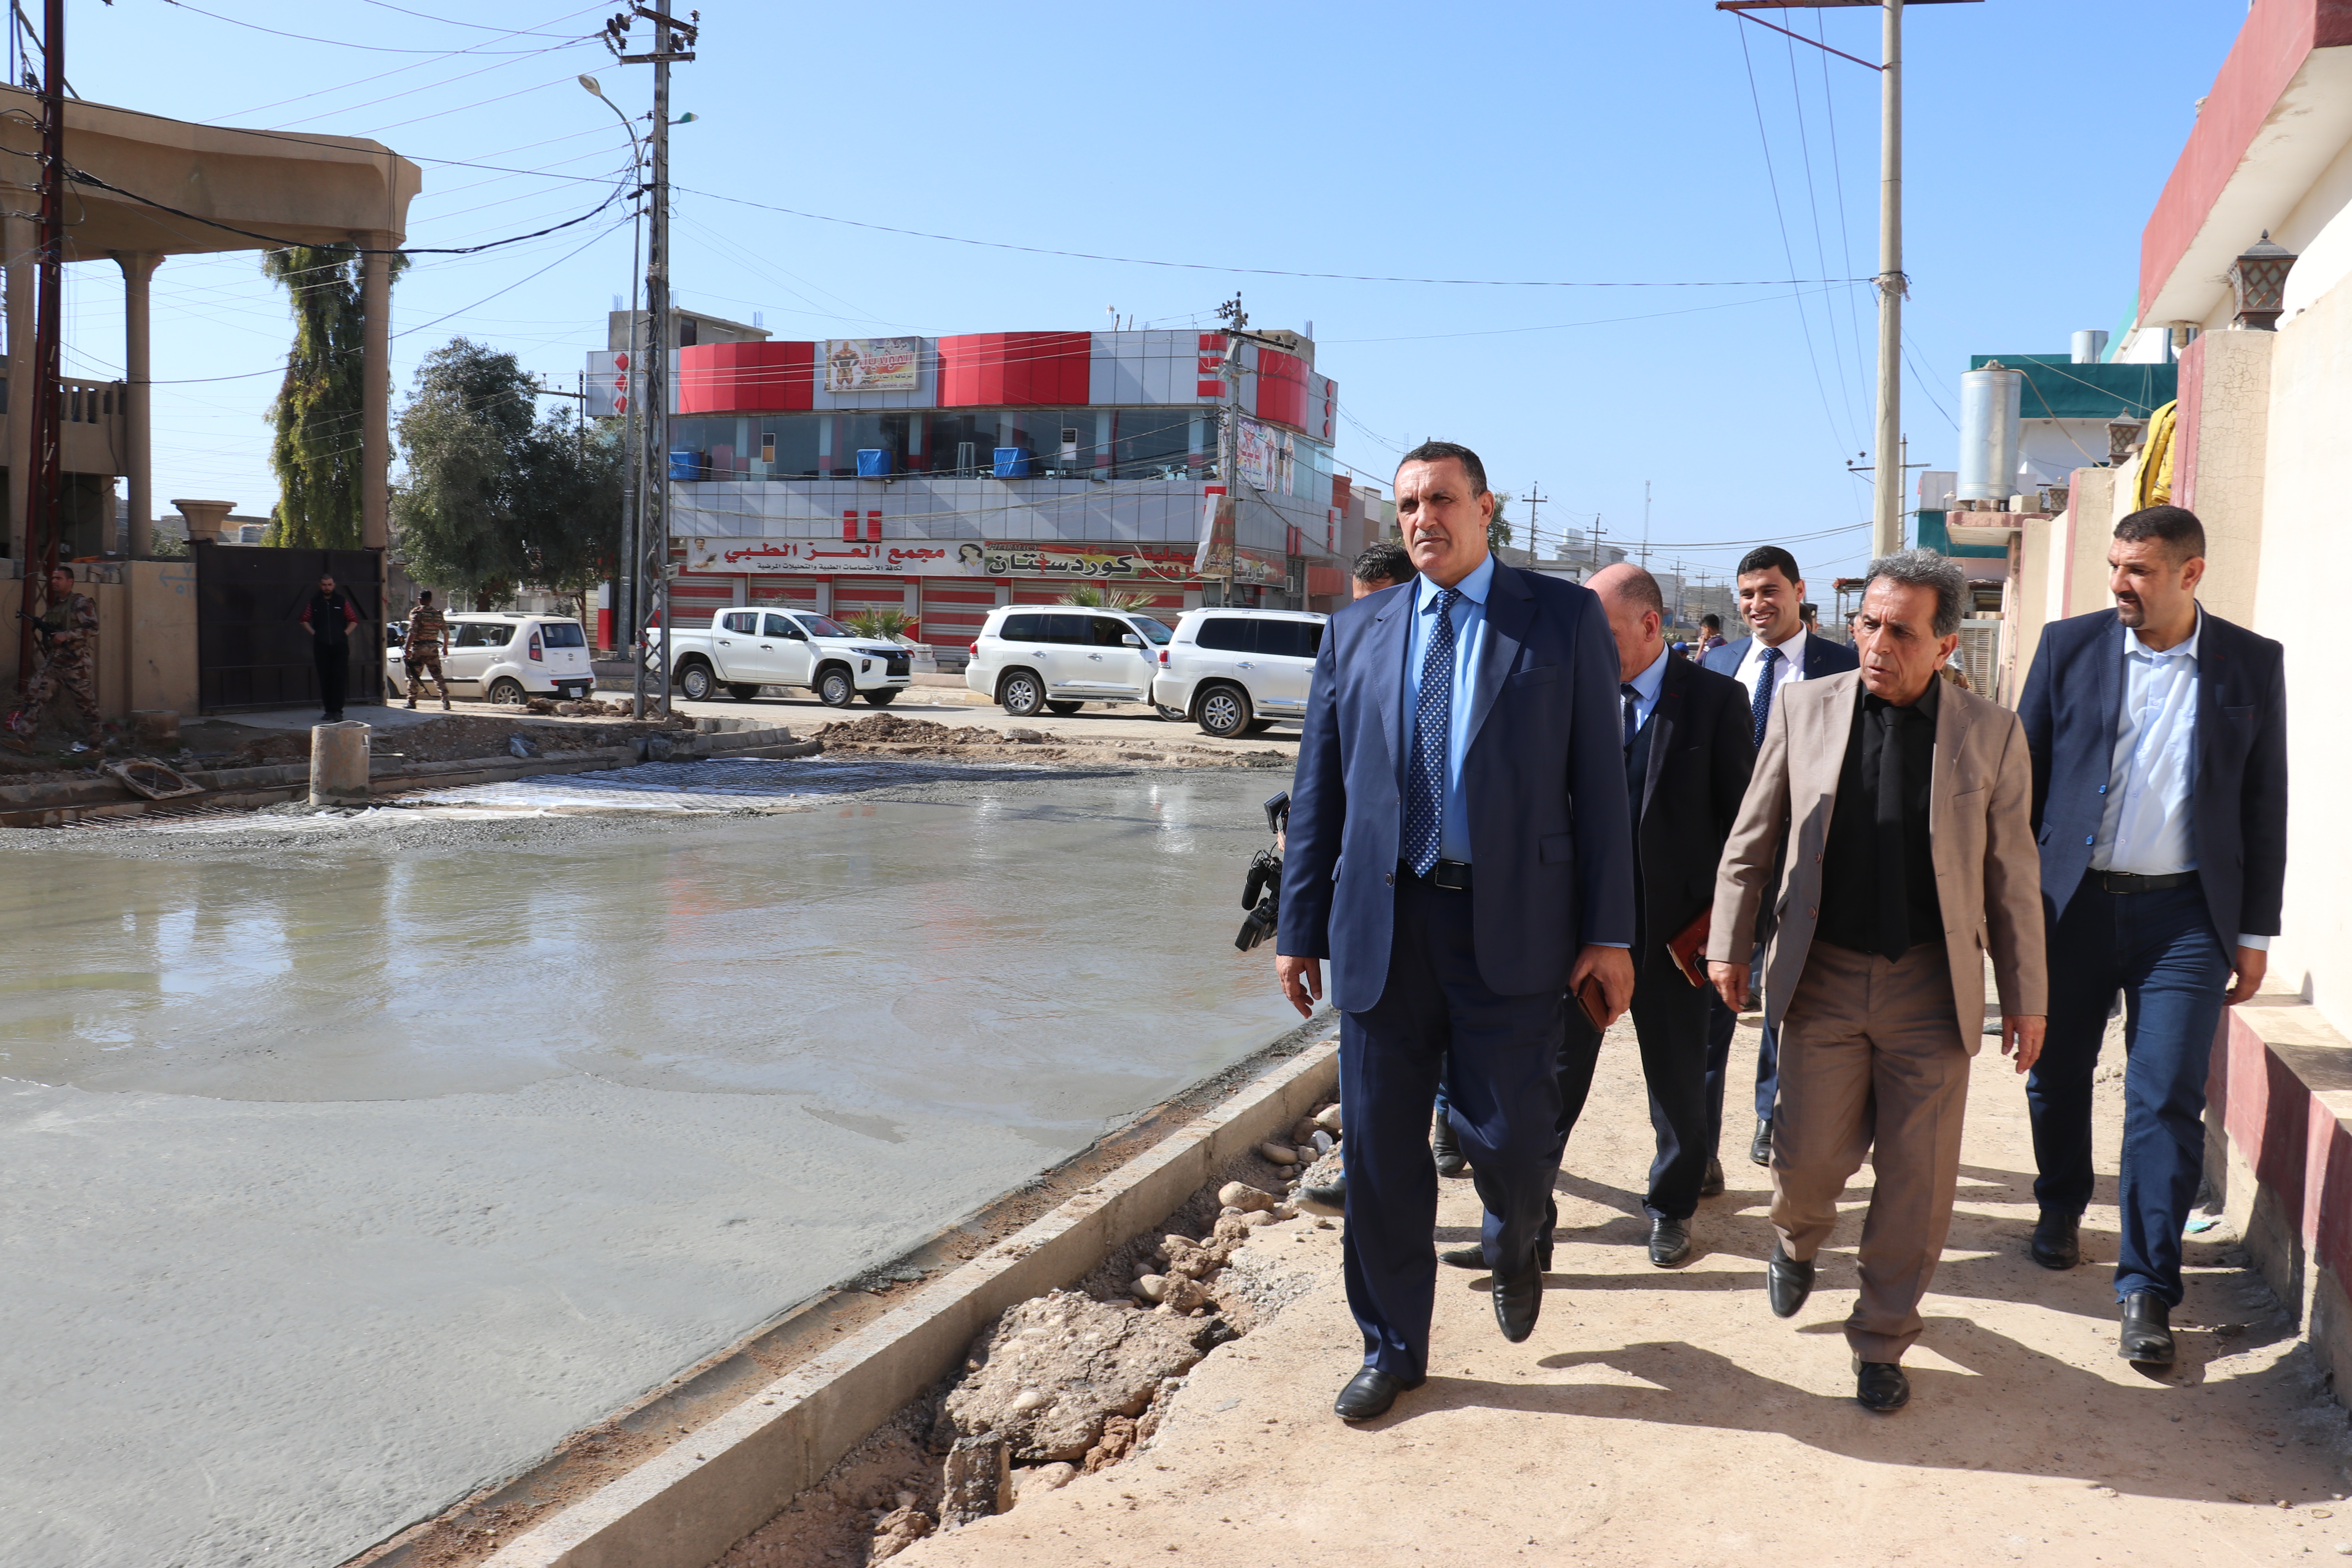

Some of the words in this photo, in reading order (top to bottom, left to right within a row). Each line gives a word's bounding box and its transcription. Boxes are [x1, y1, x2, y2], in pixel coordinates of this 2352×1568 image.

[724, 542, 797, 563] الطبي
[803, 542, 880, 561] العز
[887, 548, 945, 564] مجمع
[988, 553, 1134, 577] كوردستان
